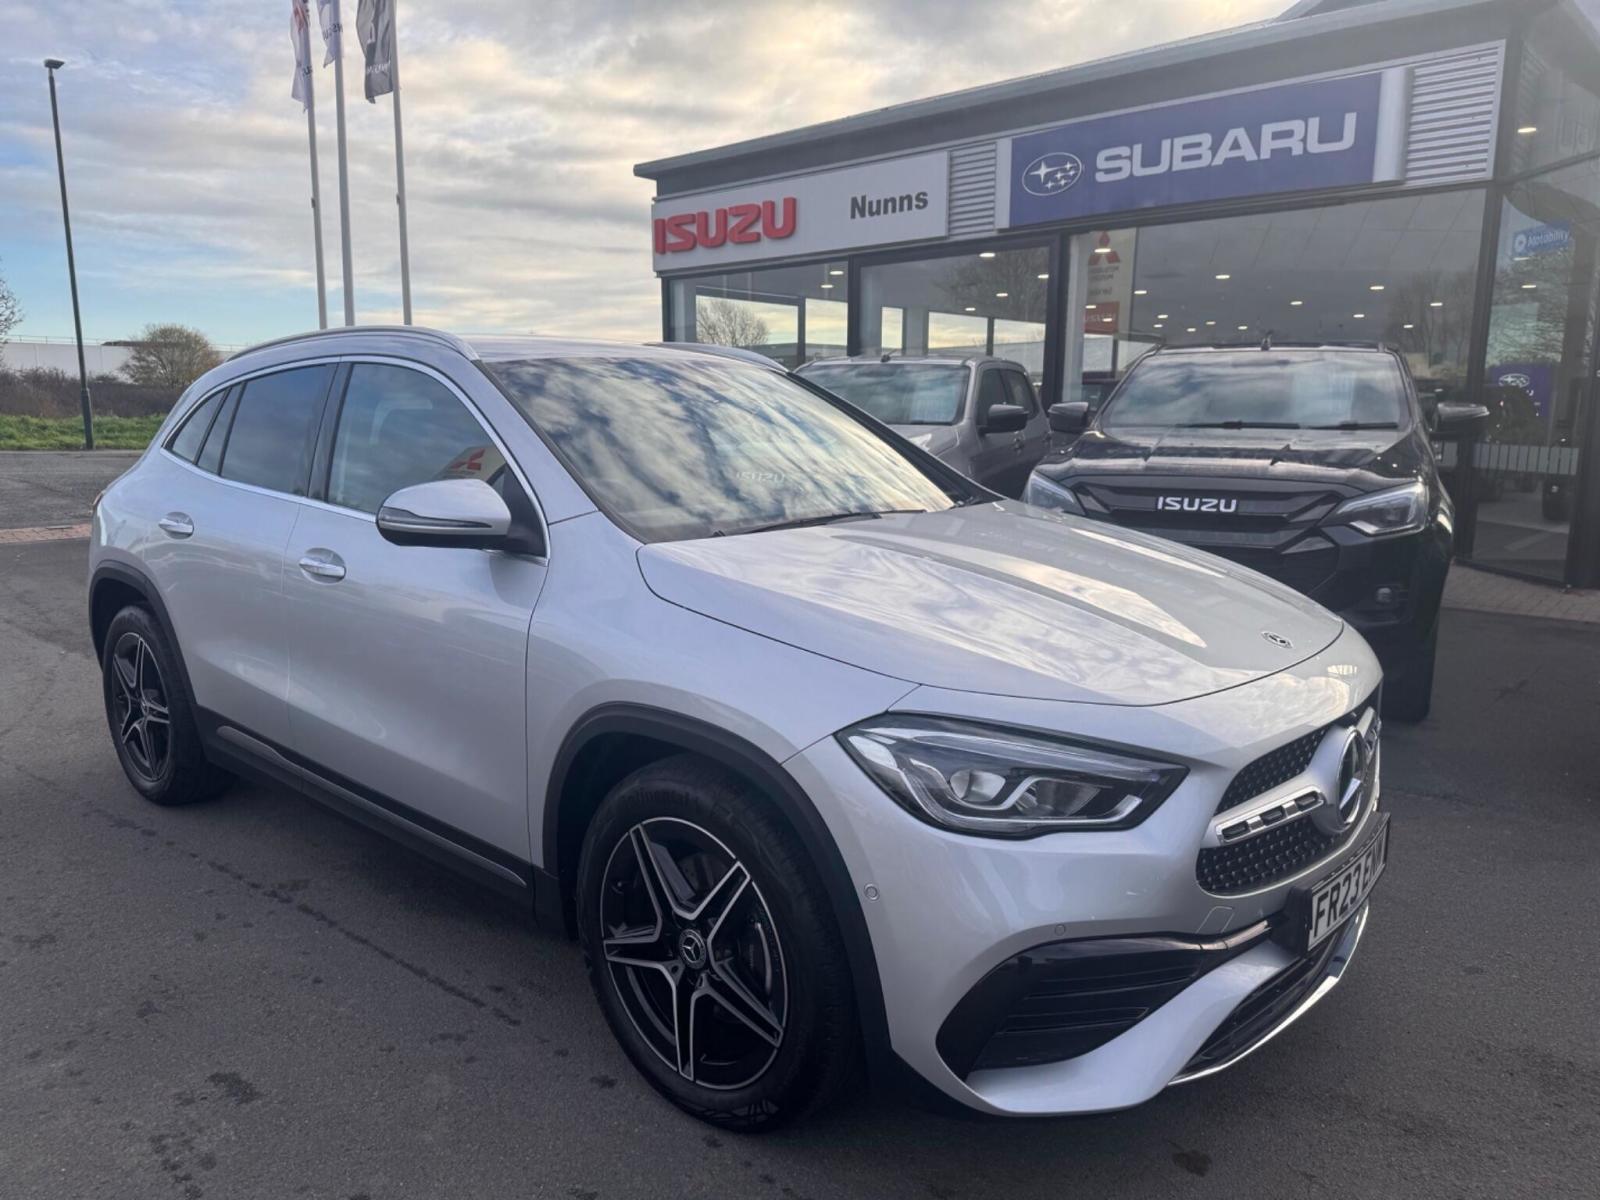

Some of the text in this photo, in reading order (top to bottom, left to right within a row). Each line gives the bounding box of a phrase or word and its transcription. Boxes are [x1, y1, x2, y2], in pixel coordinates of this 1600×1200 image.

[1094, 111, 1358, 183] SUBARU
[653, 197, 798, 256] ISUZU
[850, 191, 929, 220] Nunns
[1157, 496, 1237, 513] ISUZU
[1313, 863, 1362, 938] FR23
